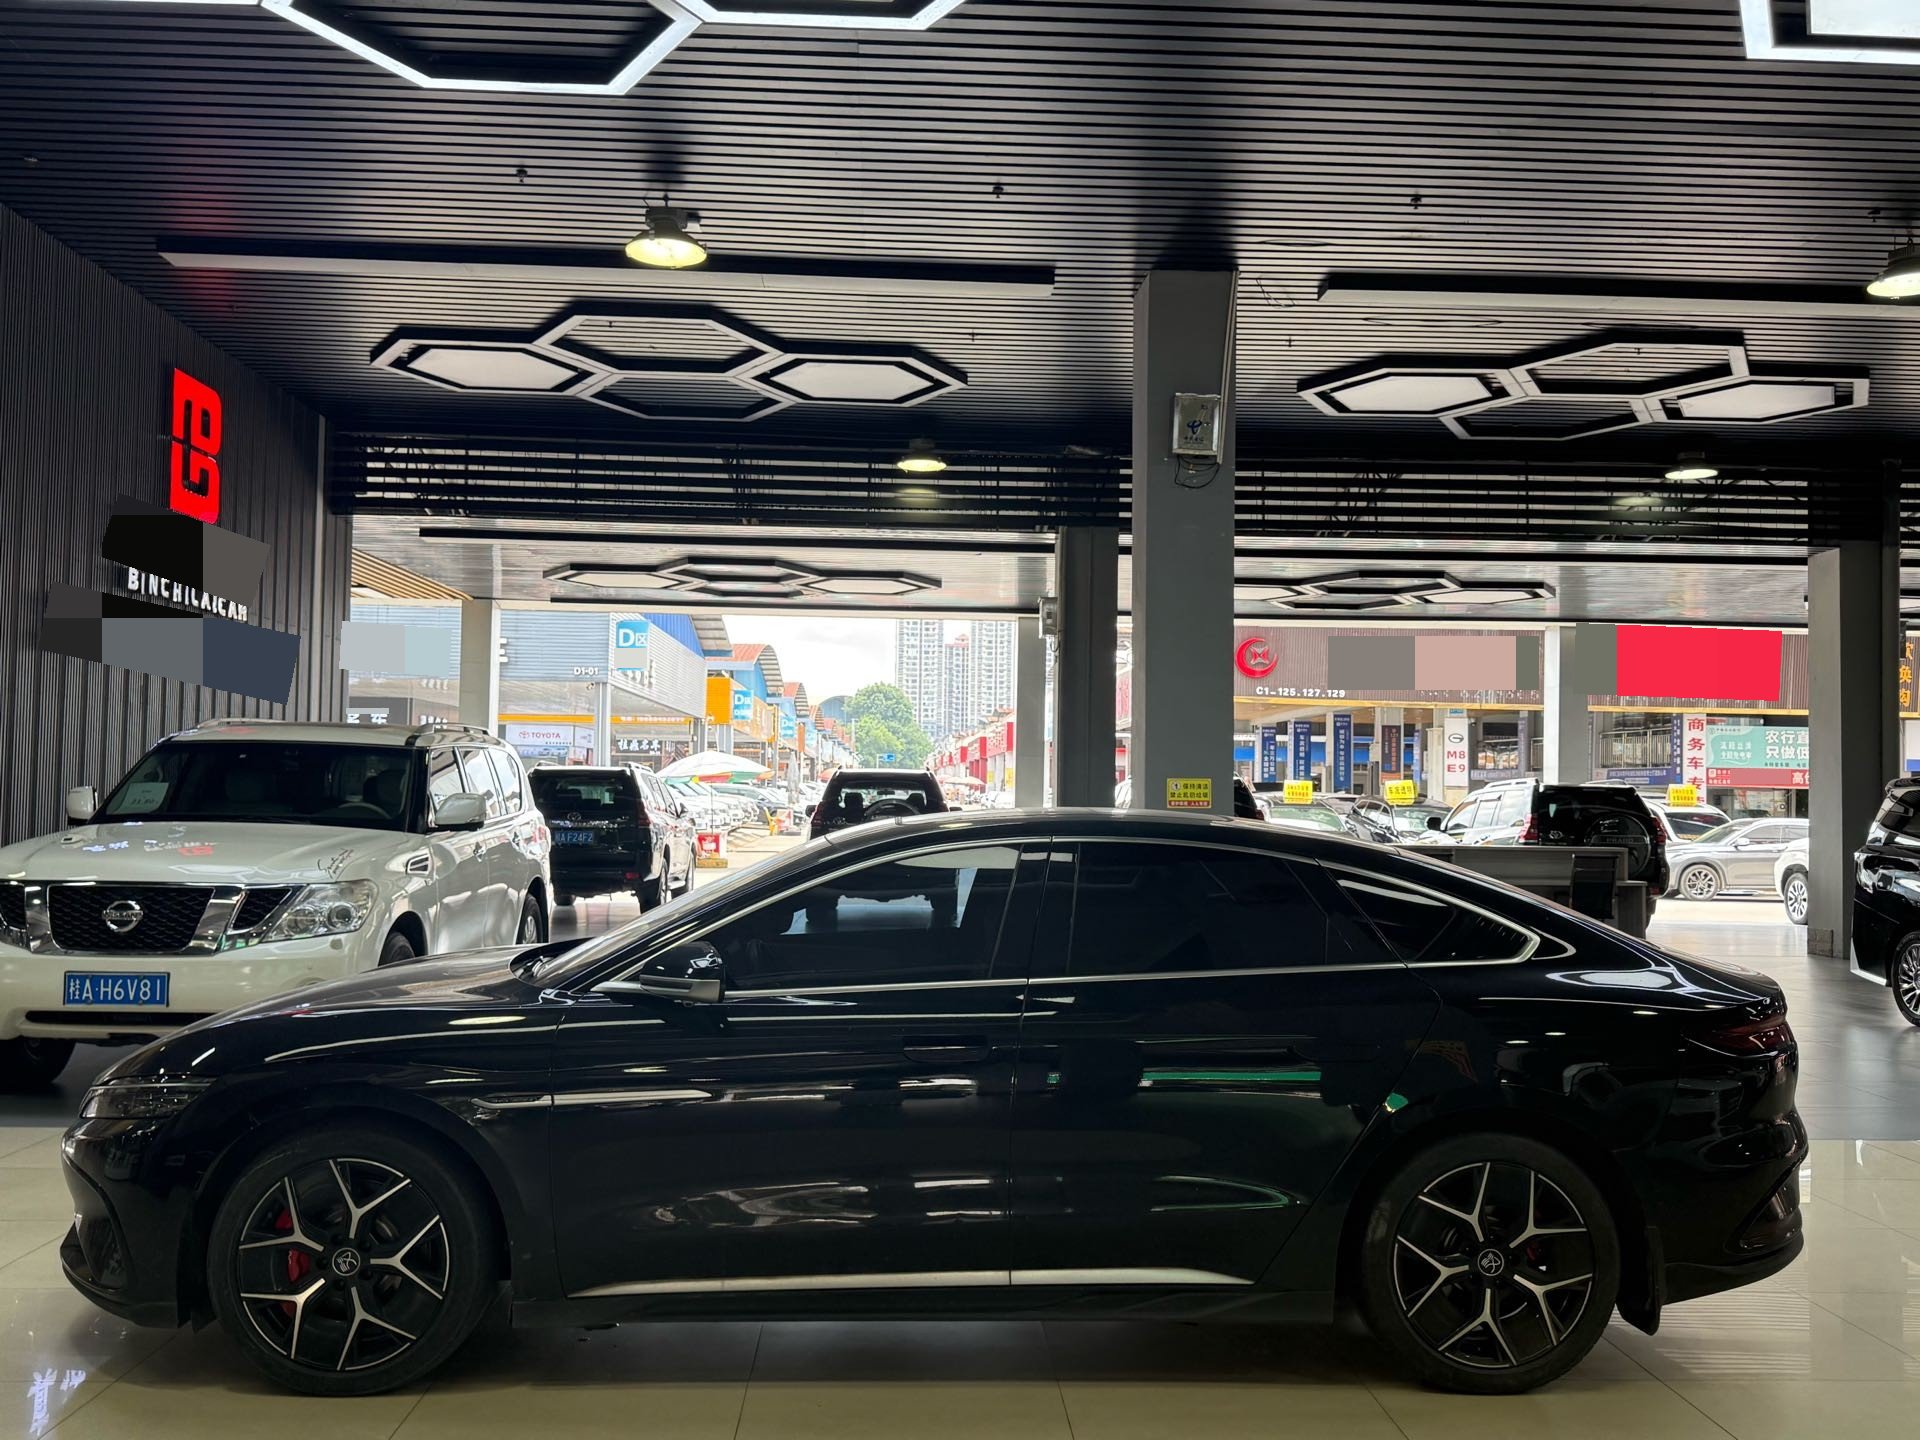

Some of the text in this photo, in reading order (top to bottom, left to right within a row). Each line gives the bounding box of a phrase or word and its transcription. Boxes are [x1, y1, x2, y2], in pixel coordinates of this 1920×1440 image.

[573, 667, 599, 675] D1-01
[1256, 686, 1345, 698] C1-125.127.129
[1446, 750, 1466, 759] M8
[1446, 764, 1466, 772] E9
